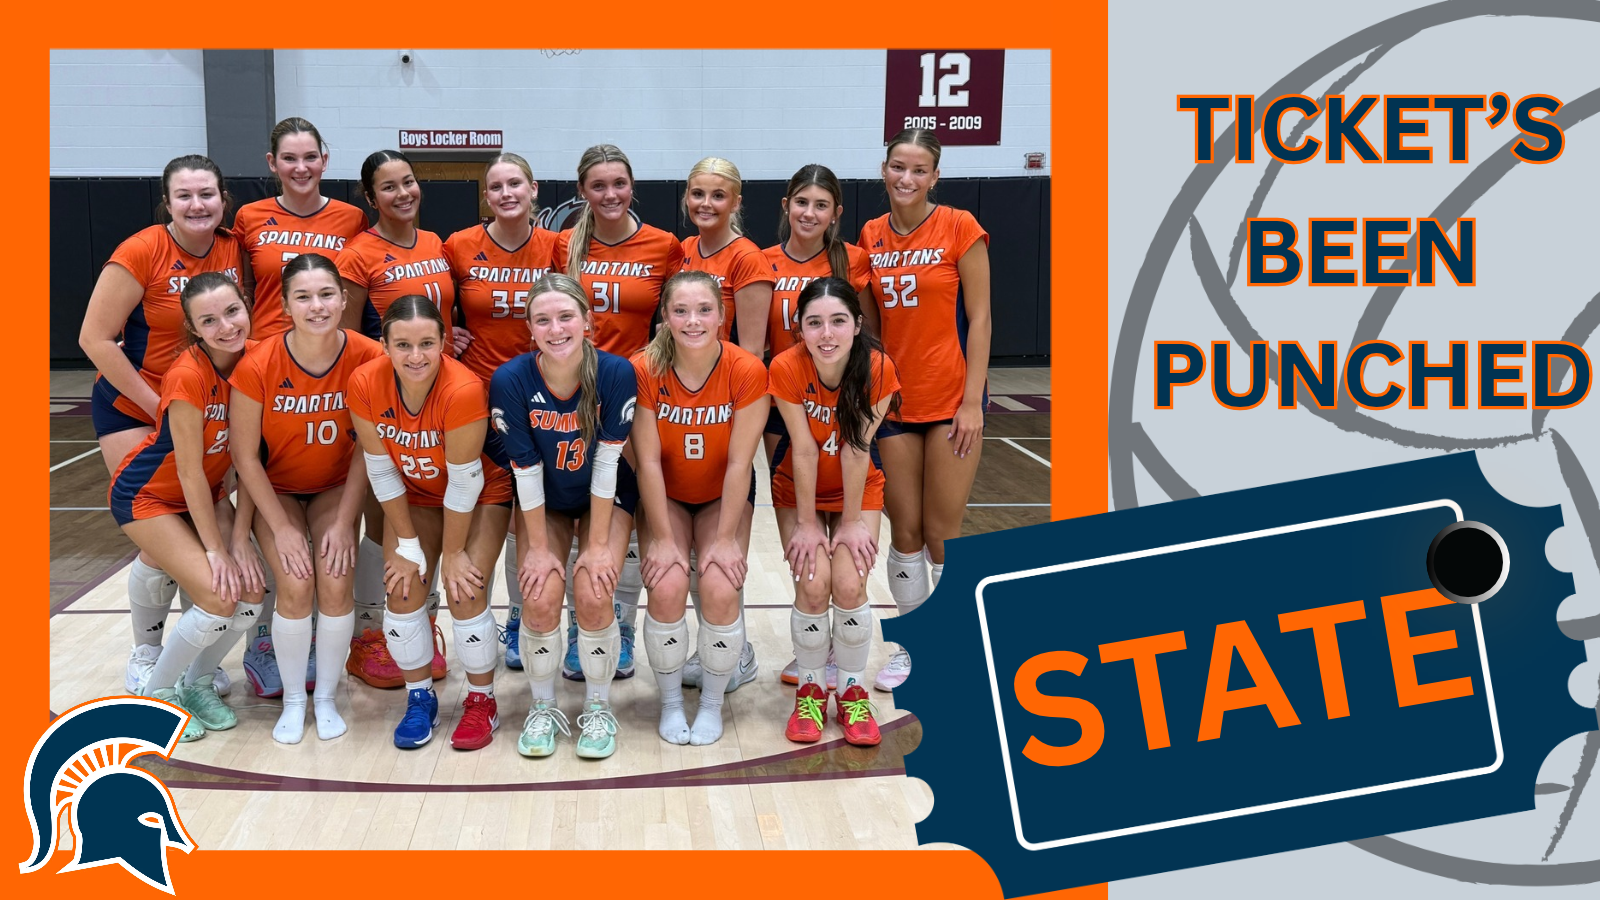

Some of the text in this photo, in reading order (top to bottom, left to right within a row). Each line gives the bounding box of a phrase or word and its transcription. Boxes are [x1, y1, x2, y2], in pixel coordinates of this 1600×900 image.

[918, 52, 971, 108] 12
[904, 116, 937, 130] 2005
[949, 116, 982, 130] 2009
[401, 131, 502, 147] Boys Locker Room
[256, 230, 347, 251] SPARTANS
[384, 257, 451, 284] SPARTANS
[579, 260, 654, 278] PARTANS
[491, 289, 528, 319] 35
[591, 281, 621, 314] 31
[880, 274, 919, 309] 32
[272, 390, 349, 414] SPARTA
[305, 419, 338, 446] 10
[375, 422, 441, 450] SPARTAN
[821, 430, 839, 456] 4
[556, 437, 586, 472] 13
[684, 433, 705, 460] 8
[400, 453, 440, 480] 25
